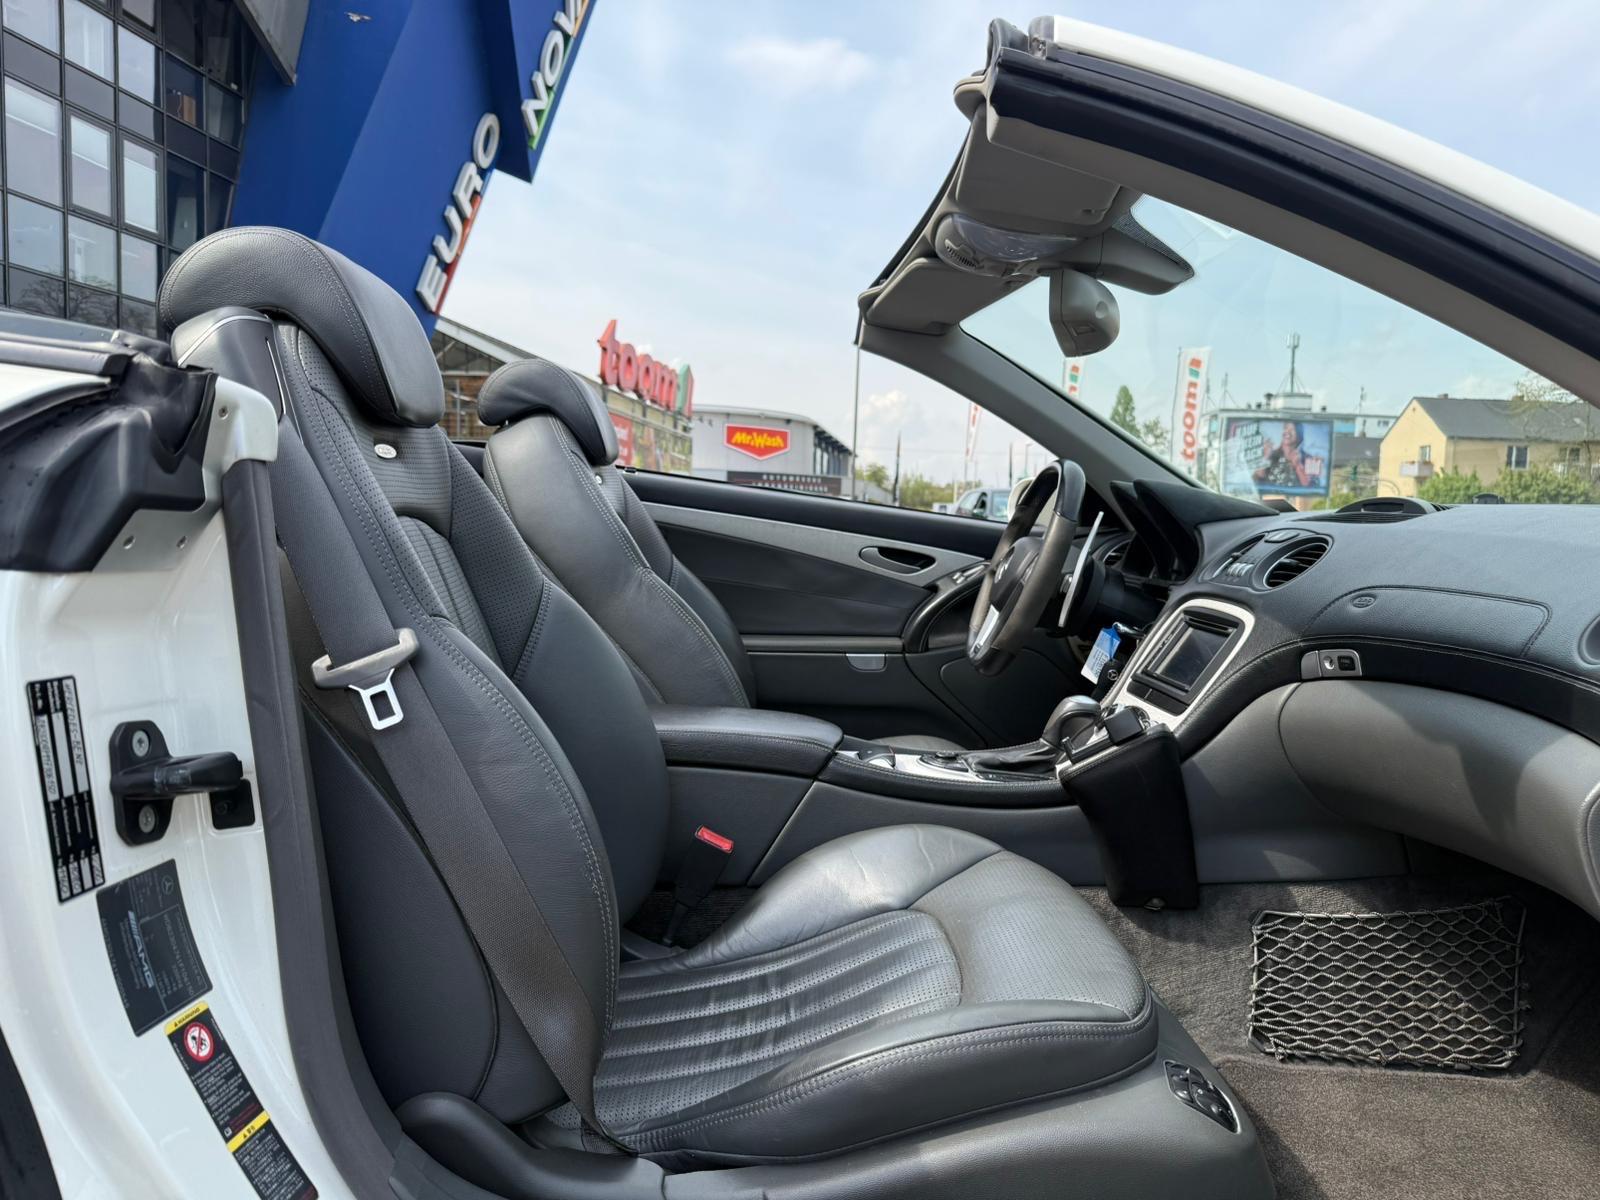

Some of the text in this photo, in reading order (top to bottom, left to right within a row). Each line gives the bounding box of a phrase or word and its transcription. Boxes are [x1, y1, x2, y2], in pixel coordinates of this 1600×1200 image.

[521, 0, 582, 137] NOV
[415, 112, 501, 313] EURO
[597, 319, 678, 413] toom
[1183, 381, 1198, 461] toom
